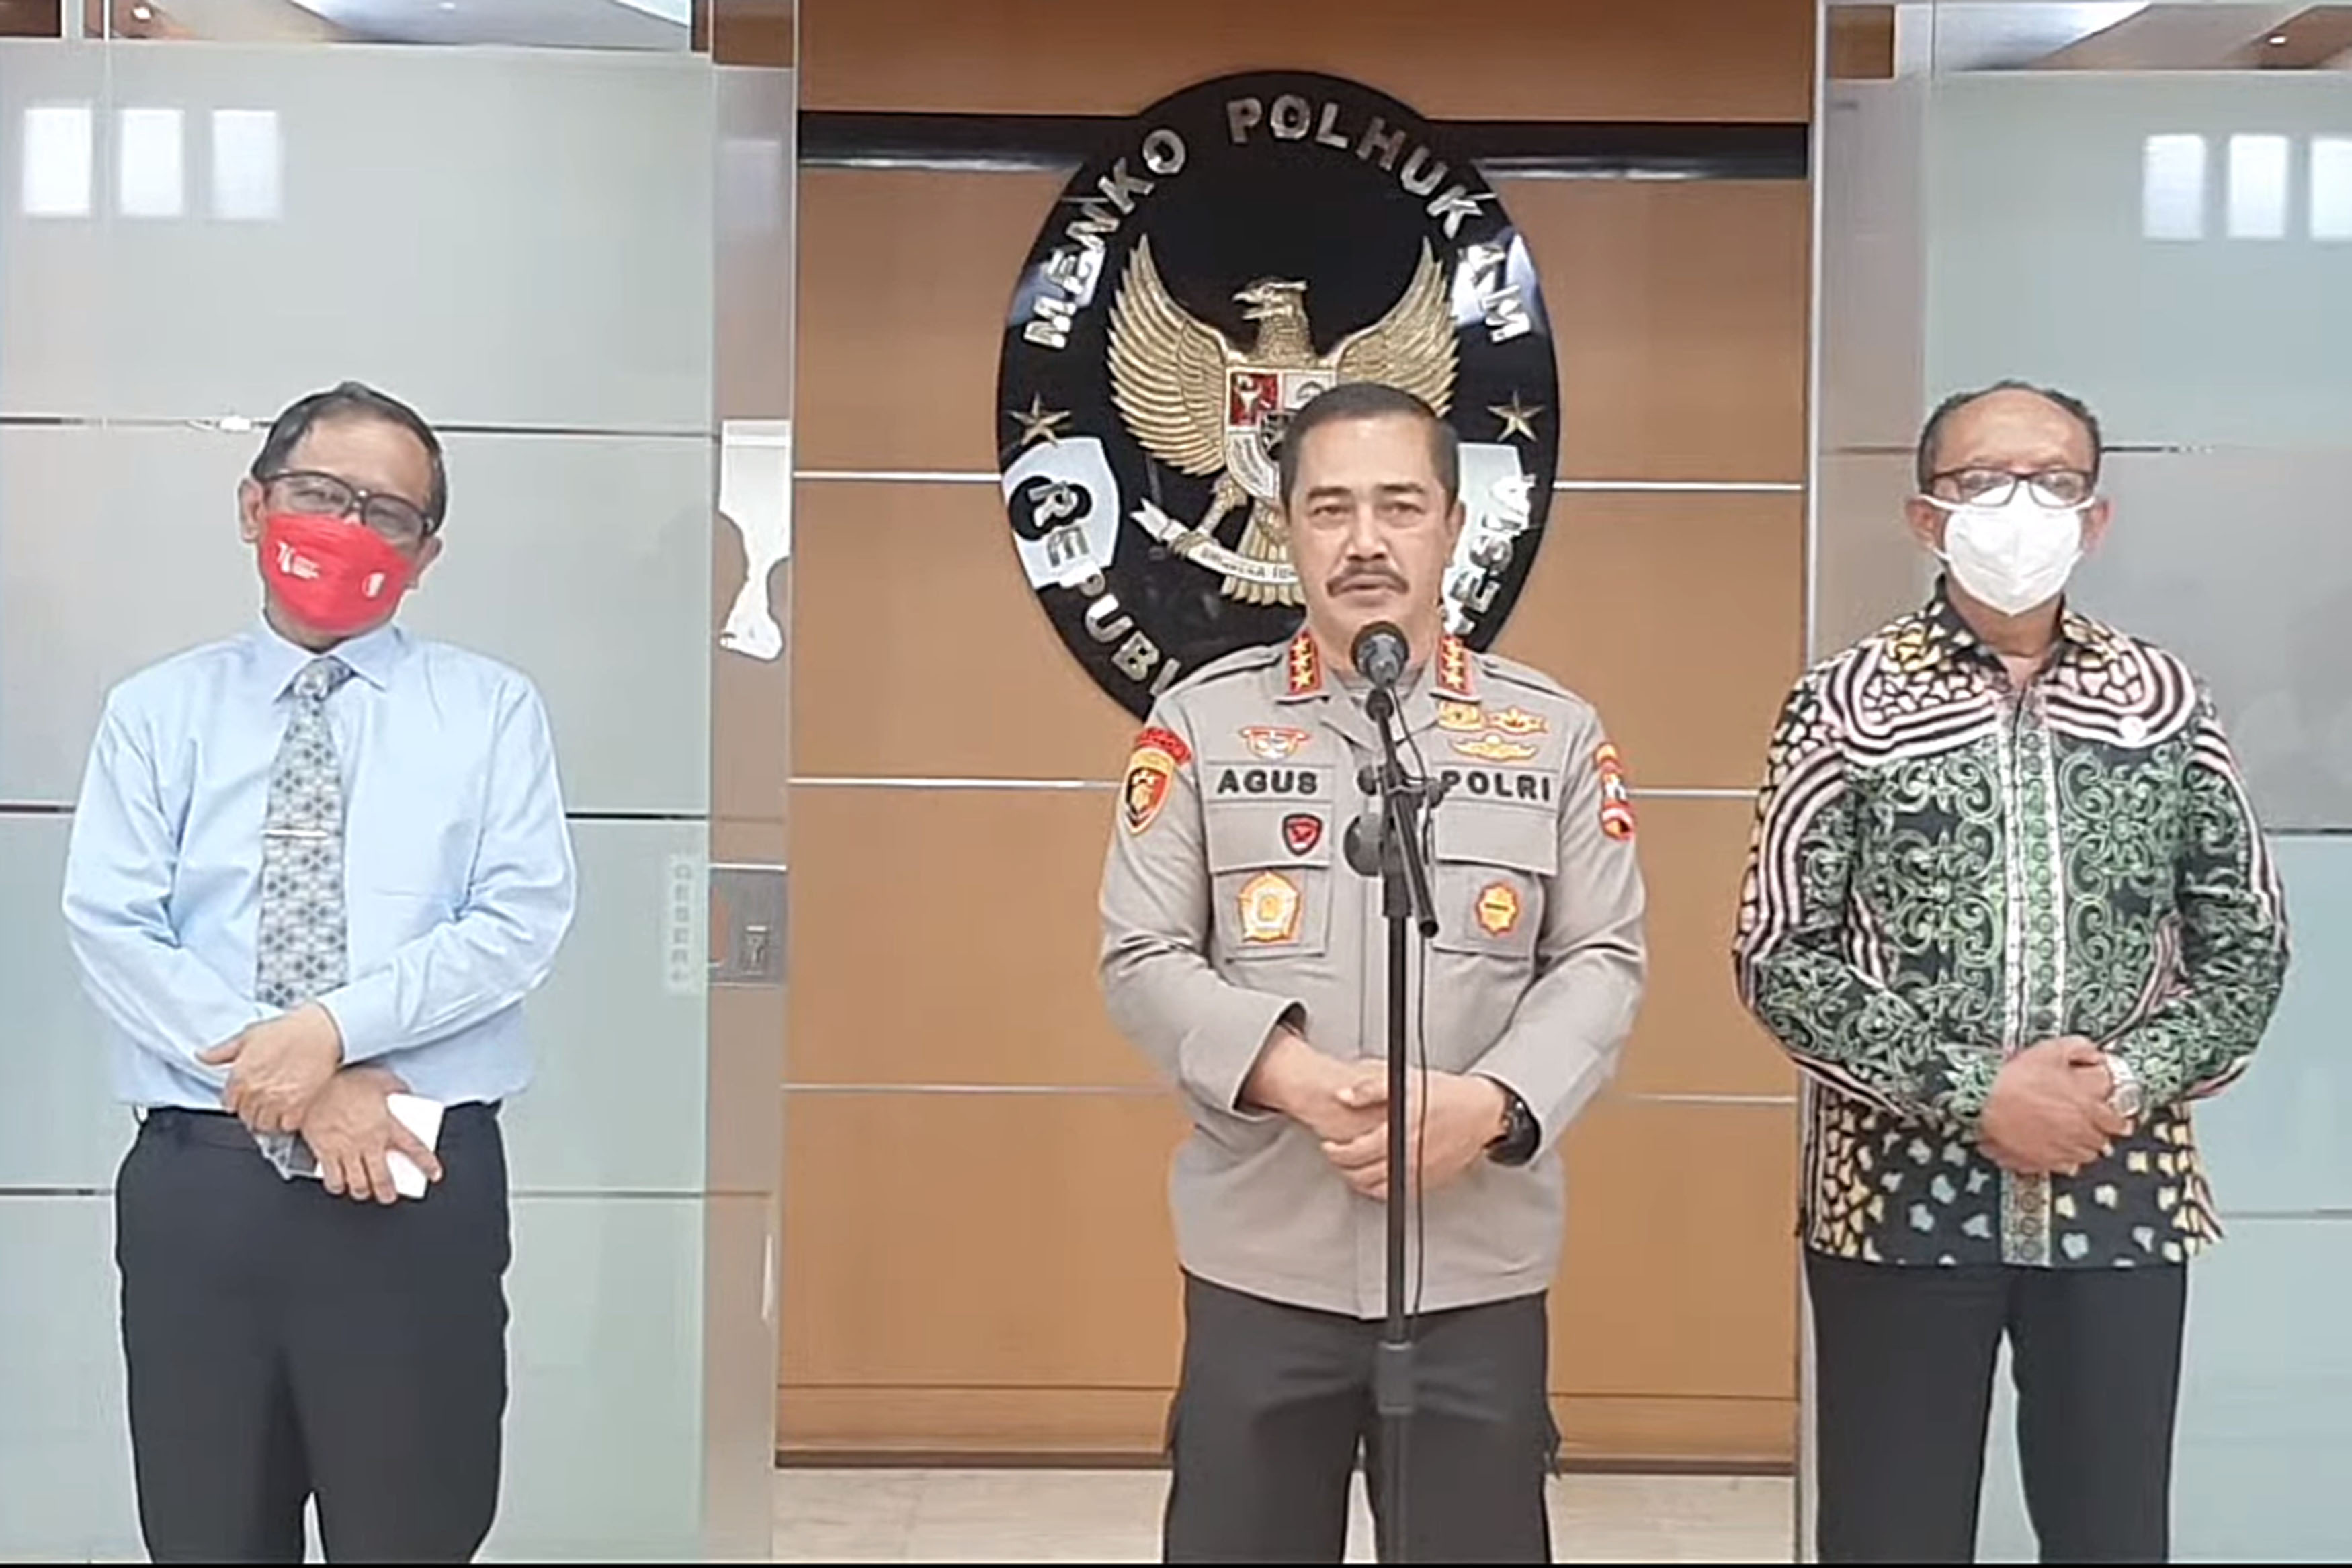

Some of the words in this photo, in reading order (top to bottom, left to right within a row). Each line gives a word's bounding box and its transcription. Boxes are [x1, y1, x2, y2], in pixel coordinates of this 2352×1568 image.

[1023, 128, 1186, 349] MENKO
[1227, 93, 1531, 343] POLHUKAM
[1216, 768, 1318, 795] AGUS
[1441, 770, 1550, 803] POLRI
